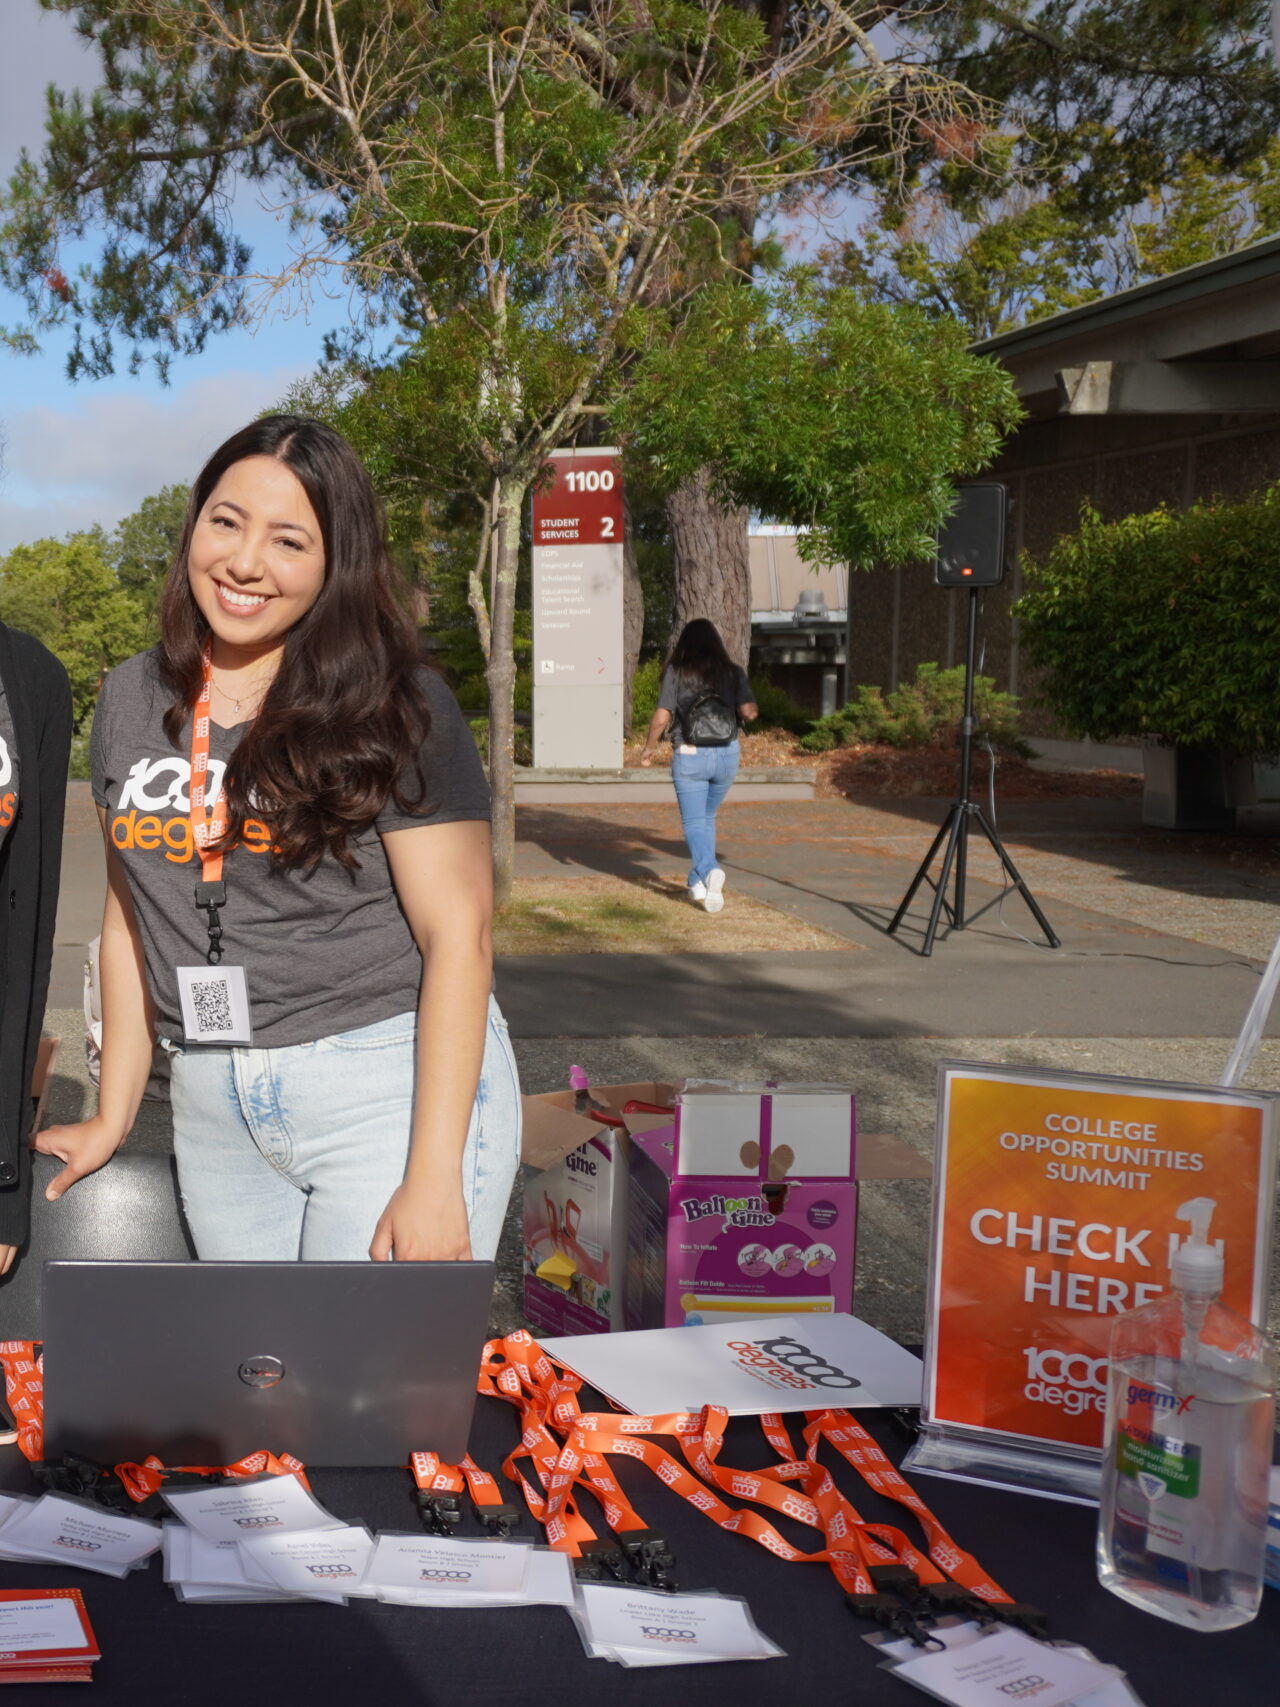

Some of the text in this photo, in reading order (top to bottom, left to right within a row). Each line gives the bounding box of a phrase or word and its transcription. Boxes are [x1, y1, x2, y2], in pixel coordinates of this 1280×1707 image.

[565, 470, 615, 492] 1100
[540, 518, 580, 528] STUDENT
[540, 529, 580, 540] SERVICES
[600, 516, 615, 538] 2
[1045, 1113, 1158, 1143] COLLEGE
[999, 1131, 1204, 1172] OPPORTUNITIES
[1045, 1161, 1152, 1191] SUMMIT
[683, 1195, 762, 1222] Balloon
[731, 1211, 775, 1226] time
[969, 1207, 1152, 1268] CHECK
[1023, 1265, 1164, 1316] HERE
[726, 1341, 817, 1390] degrees
[1023, 1381, 1108, 1416] degre
[1122, 1449, 1191, 1483] hand sanitizer
